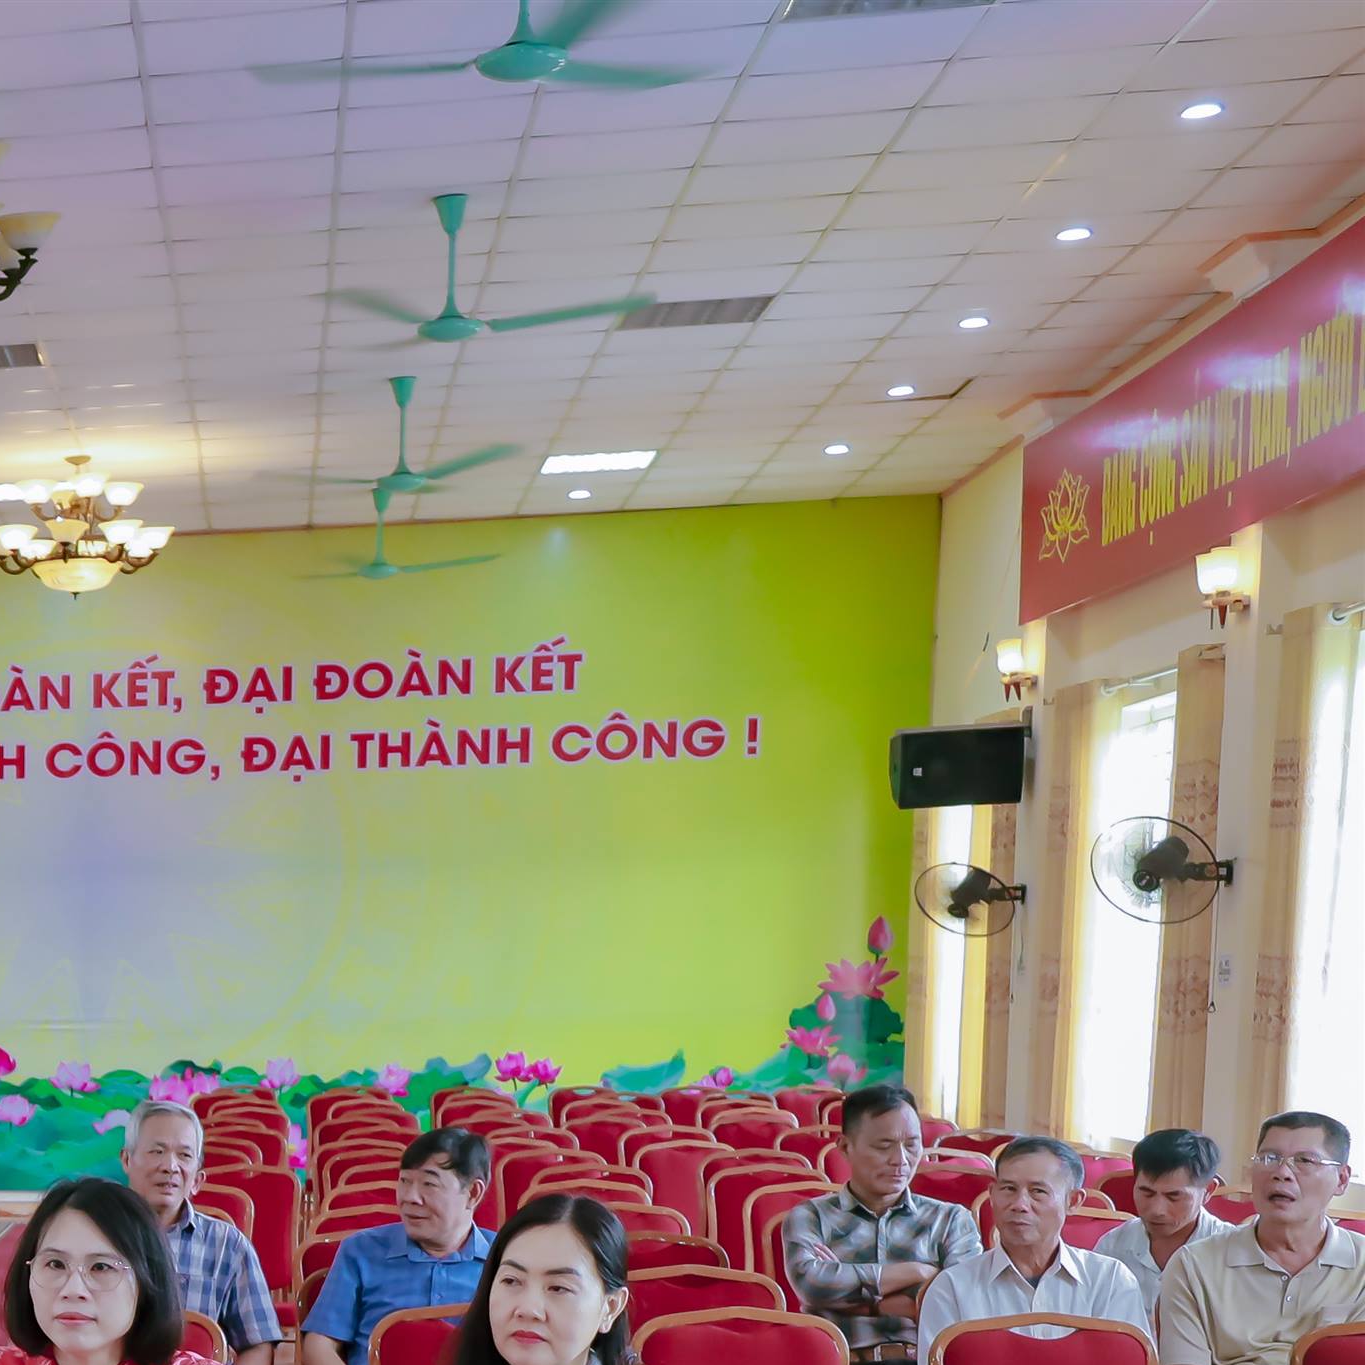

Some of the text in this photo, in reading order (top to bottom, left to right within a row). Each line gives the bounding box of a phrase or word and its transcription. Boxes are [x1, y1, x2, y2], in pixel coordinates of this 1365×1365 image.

[91, 653, 183, 713] KẾT,
[202, 665, 294, 714] ĐẠI
[313, 648, 471, 701] ĐOÀN
[494, 635, 584, 694] KẾT
[44, 730, 222, 781] CÔNG,
[239, 733, 332, 782] ĐẠI
[349, 718, 531, 770] THÀNH
[550, 711, 727, 764] CÔNG
[744, 716, 760, 757] !
